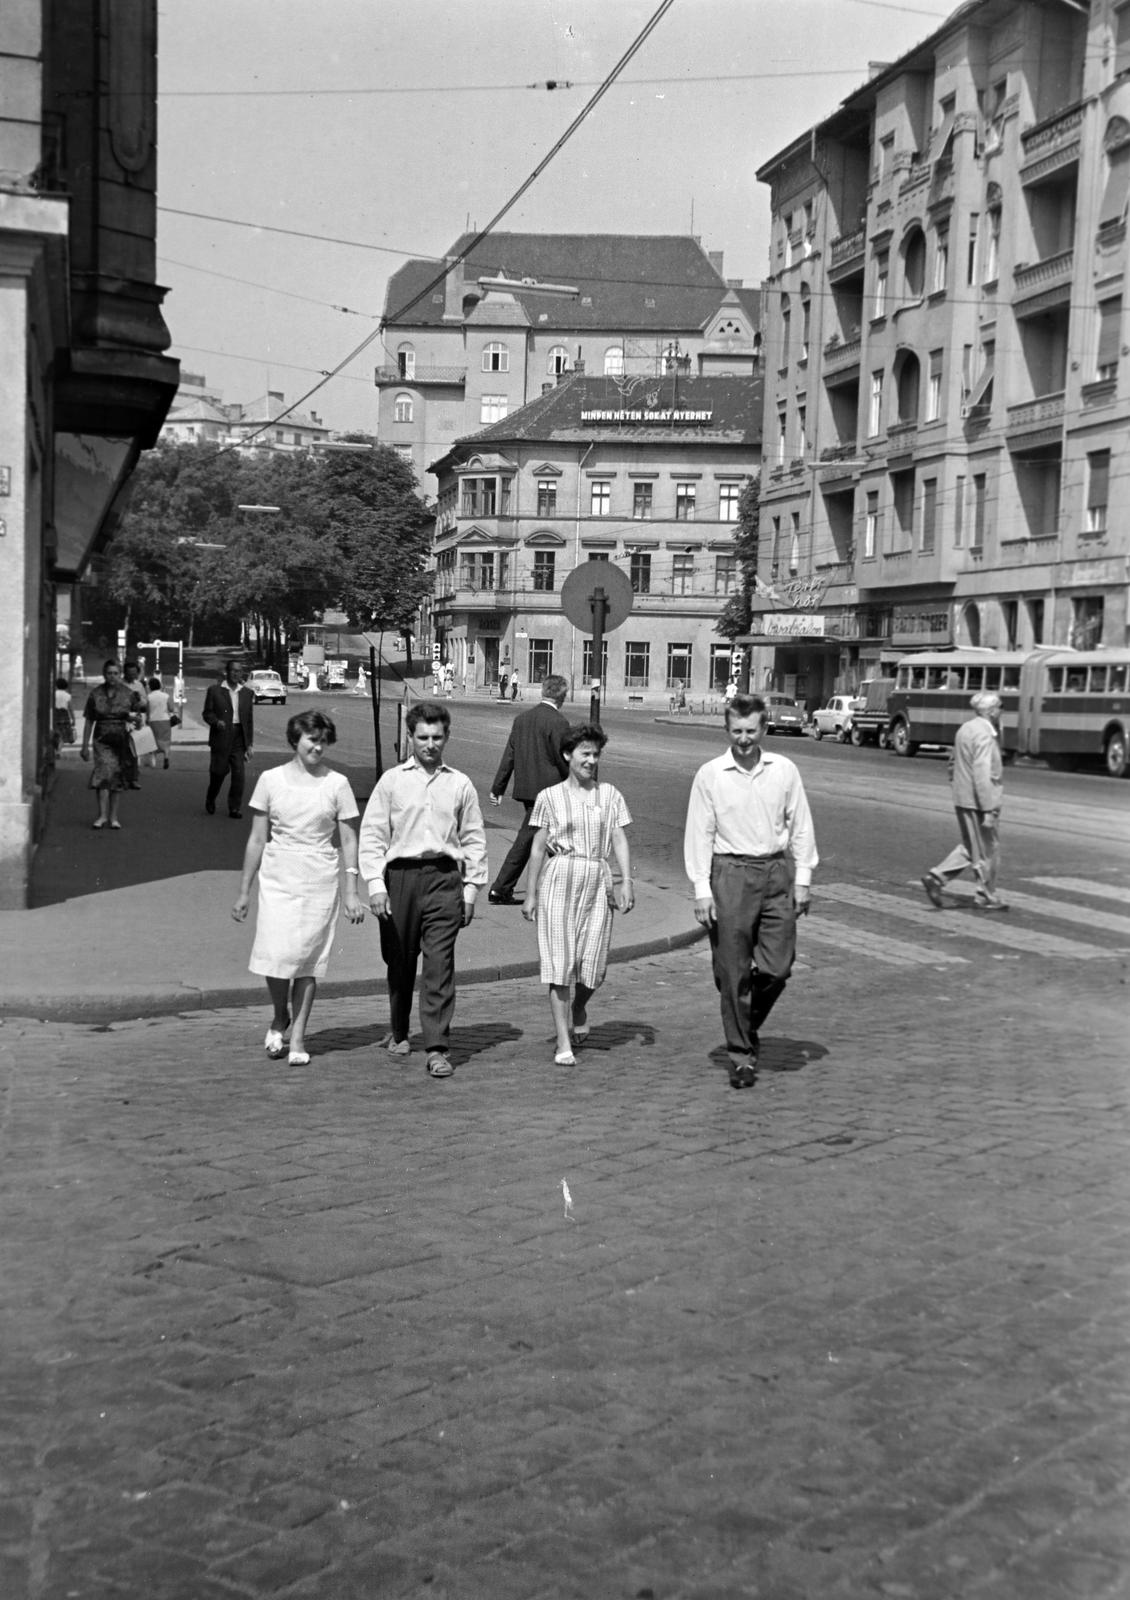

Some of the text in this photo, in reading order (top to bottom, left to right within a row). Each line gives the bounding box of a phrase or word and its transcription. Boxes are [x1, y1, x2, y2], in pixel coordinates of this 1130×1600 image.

[581, 410, 612, 420] MINDEN
[644, 410, 672, 420] SOKAT
[673, 410, 712, 420] NYERHET
